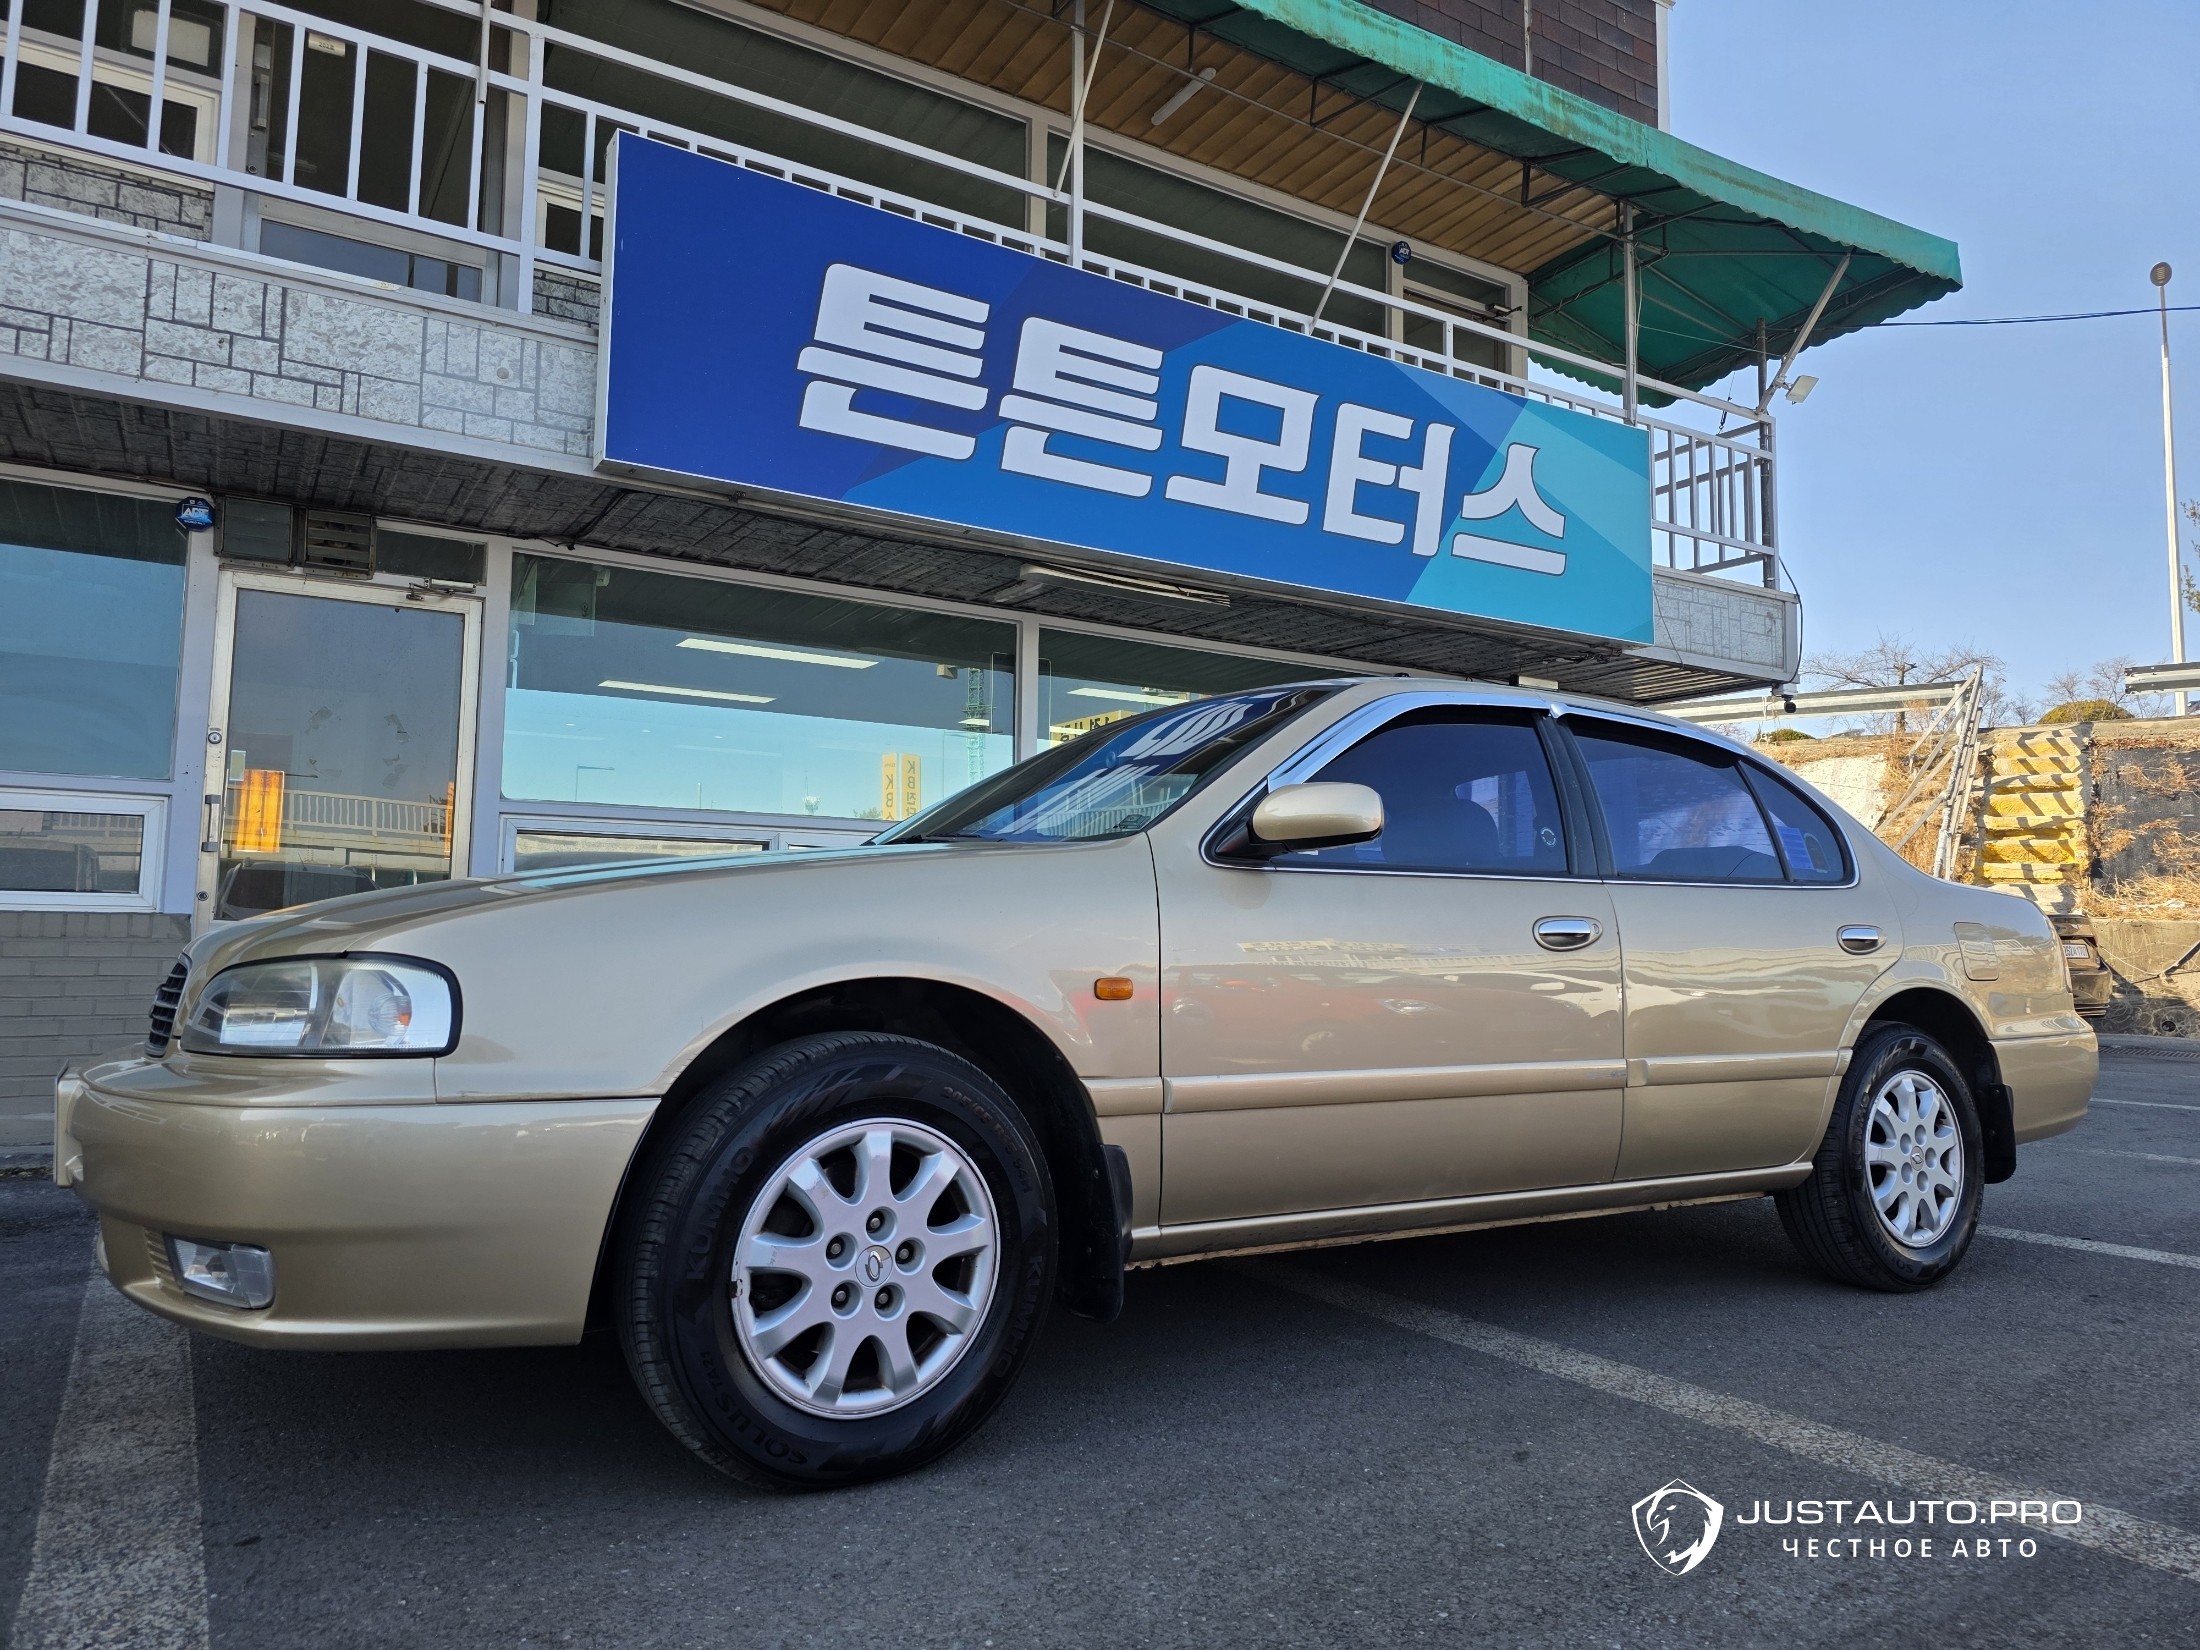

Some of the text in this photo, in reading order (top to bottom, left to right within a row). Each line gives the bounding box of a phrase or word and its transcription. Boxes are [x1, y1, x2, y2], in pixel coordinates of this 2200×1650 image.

[797, 263, 1567, 577] 튼튼모터스
[182, 507, 209, 519] ADT
[686, 1146, 755, 1280] KUMHO
[990, 1254, 1044, 1378] KUMHO
[714, 1389, 809, 1465] SOLUS
